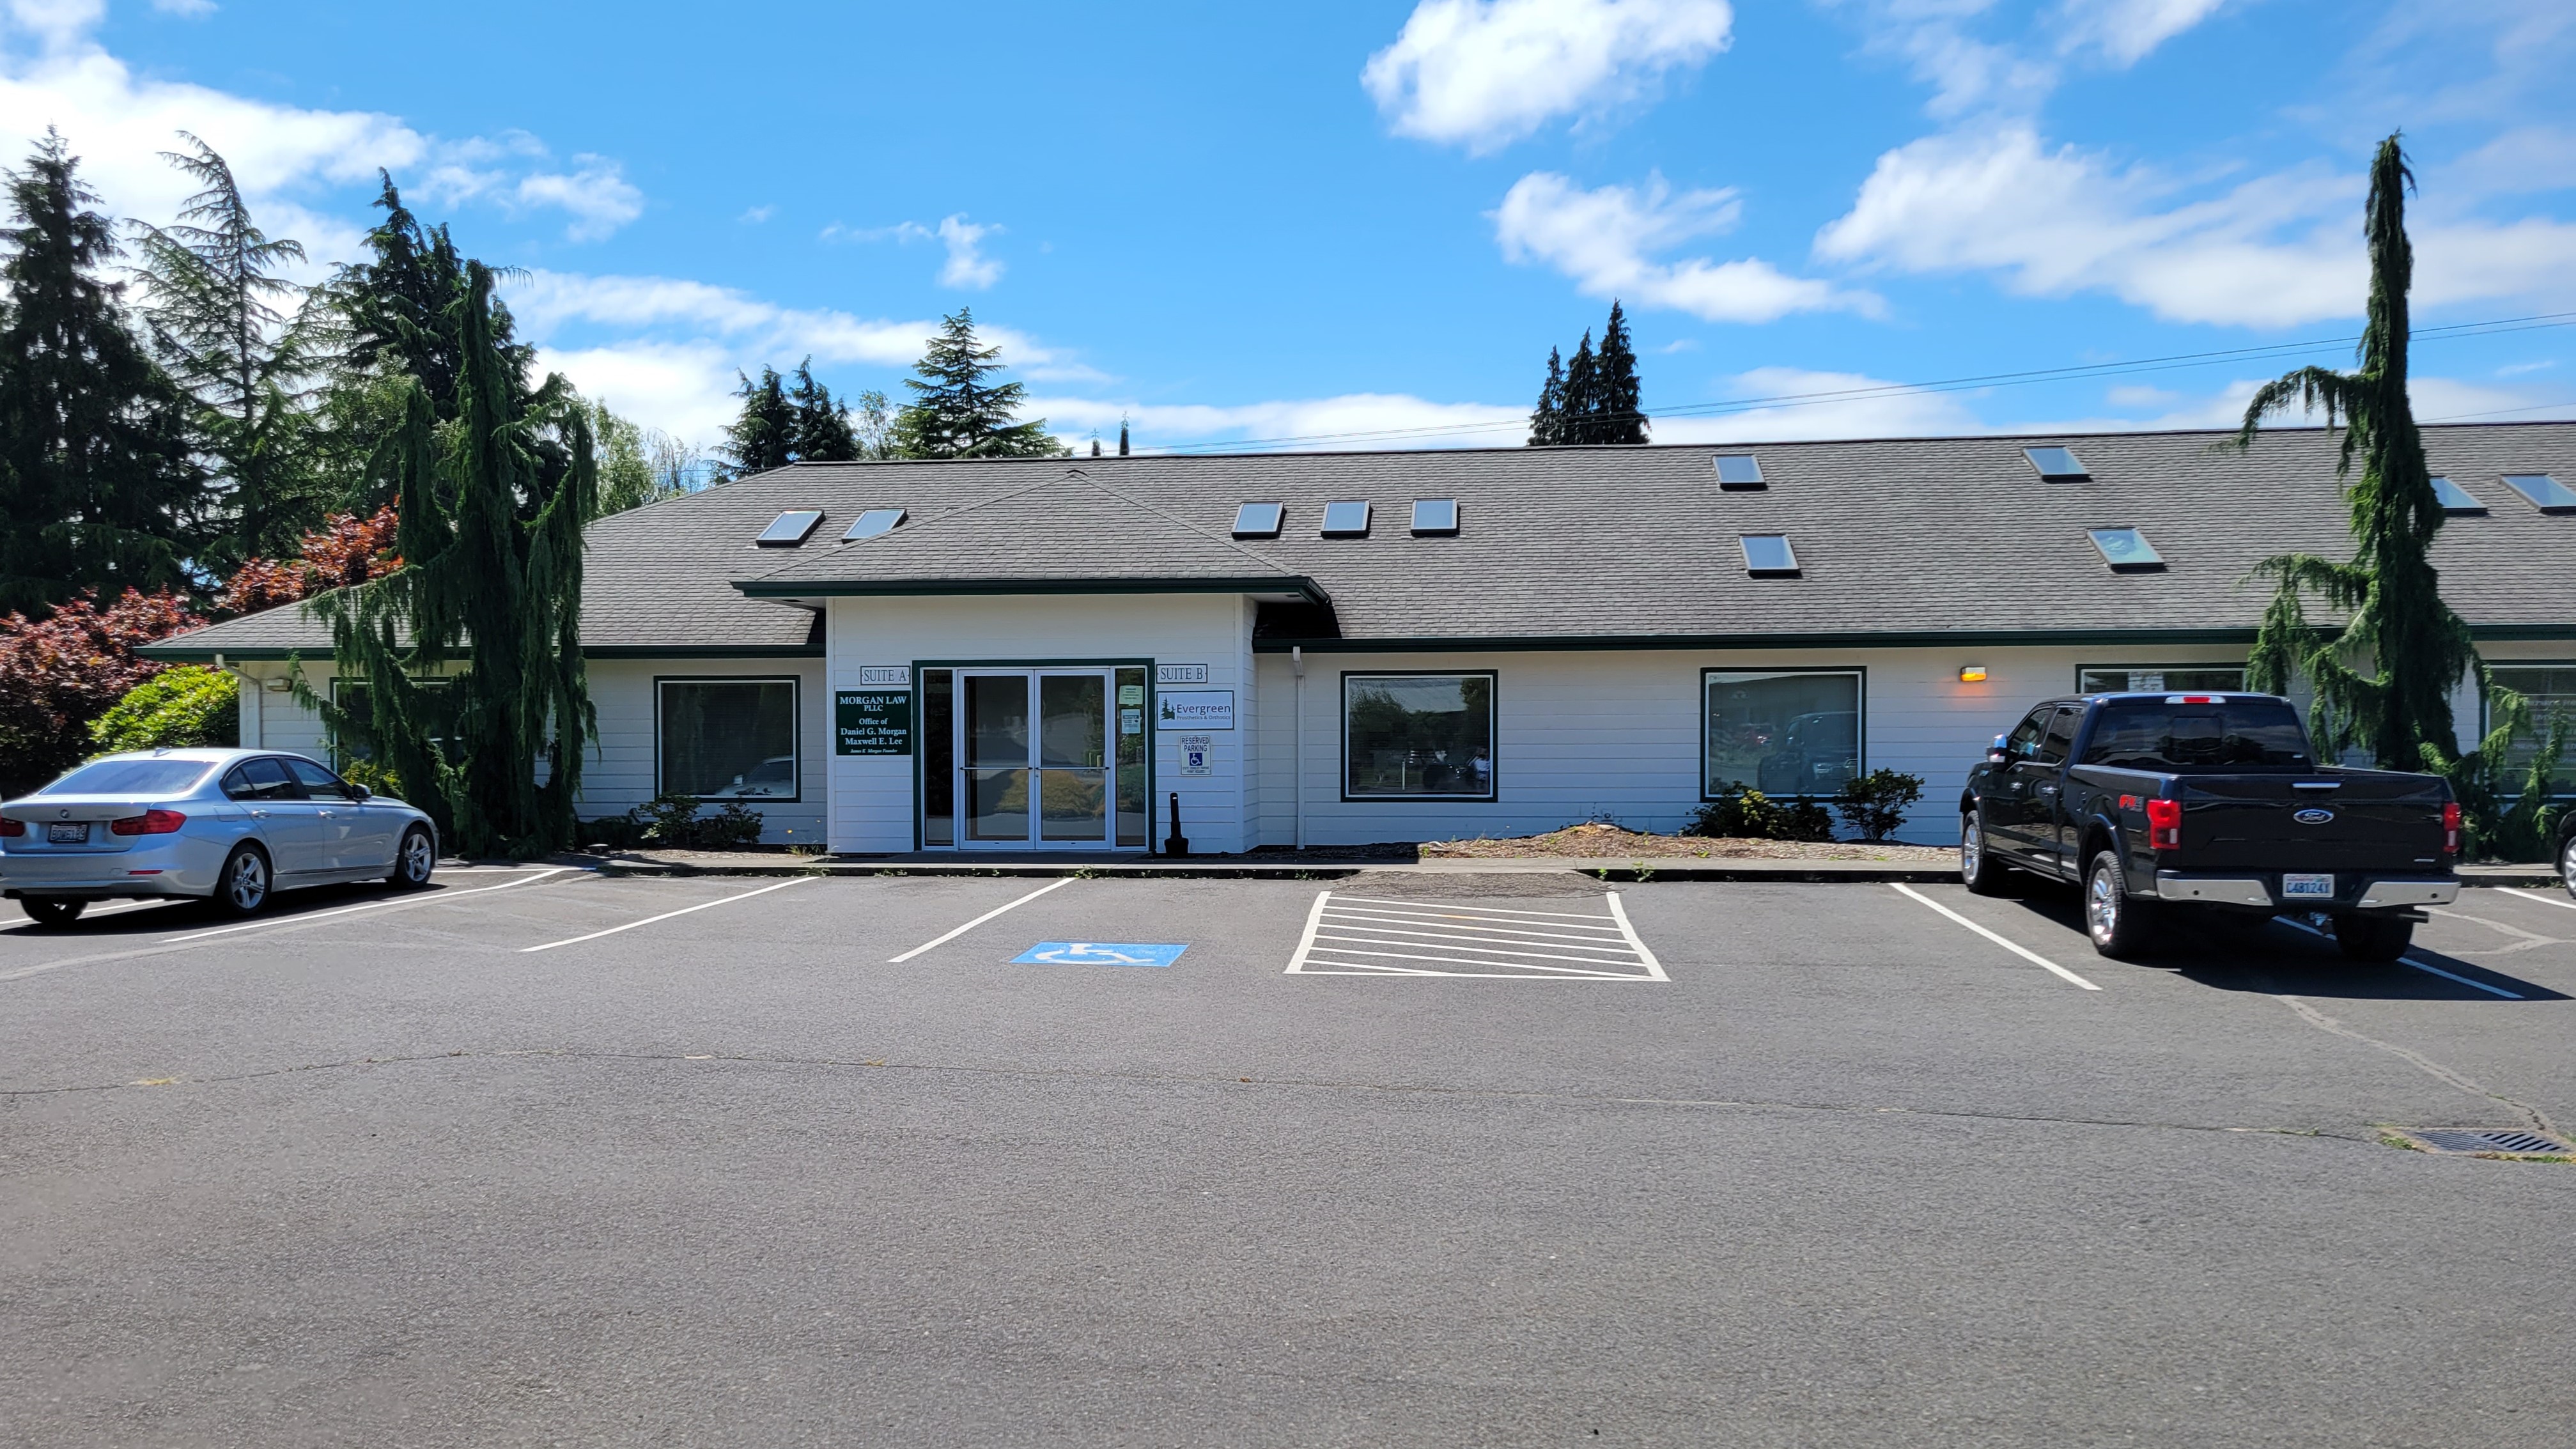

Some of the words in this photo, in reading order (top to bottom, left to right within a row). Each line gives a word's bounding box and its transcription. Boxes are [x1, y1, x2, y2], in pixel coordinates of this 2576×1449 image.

[864, 669, 894, 681] SUITE
[899, 669, 906, 681] A
[1160, 667, 1192, 679] SUITE
[1197, 667, 1203, 679] B
[839, 696, 883, 704] MORGAN
[886, 696, 907, 704] LAW
[1176, 704, 1230, 716] Evergreen
[878, 727, 907, 737] Morgan
[2303, 812, 2325, 821] Ford
